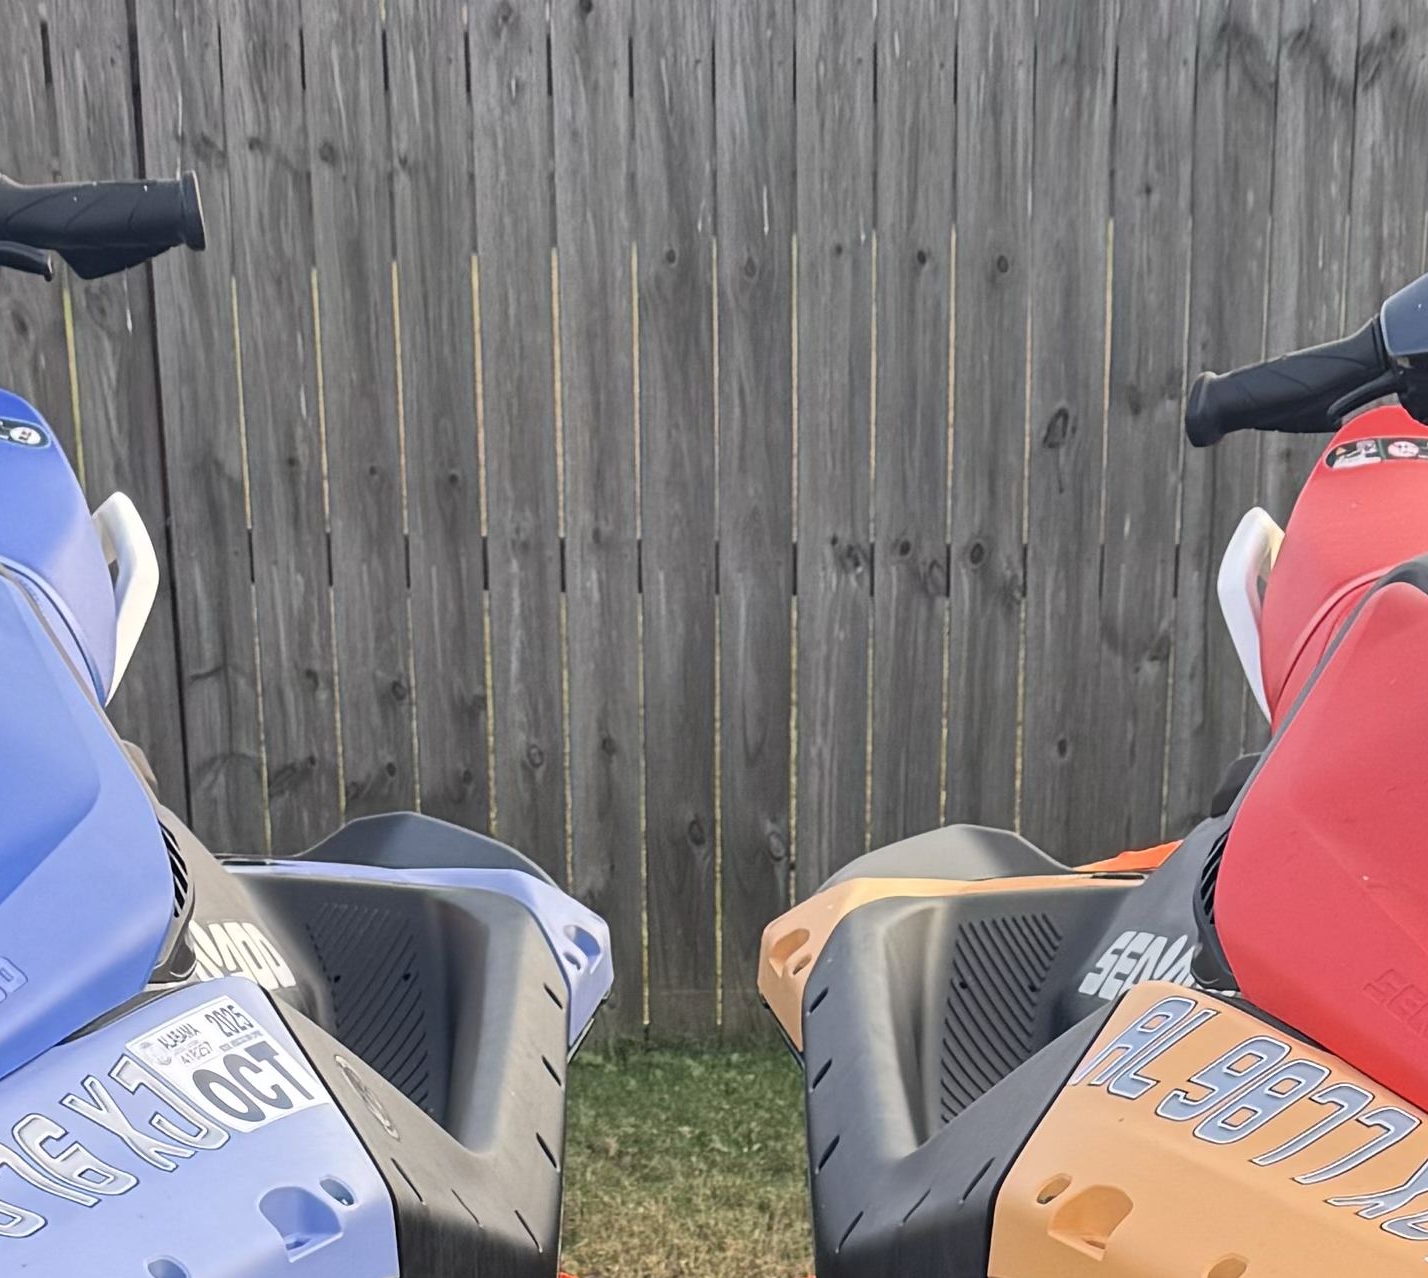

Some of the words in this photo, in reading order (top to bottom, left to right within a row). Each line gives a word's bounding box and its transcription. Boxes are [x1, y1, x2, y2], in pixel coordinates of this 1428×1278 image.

[203, 1004, 255, 1038] 2025
[59, 1053, 231, 1172] XJ
[192, 1040, 316, 1122] OCT
[1154, 1035, 1422, 1185] 9877
